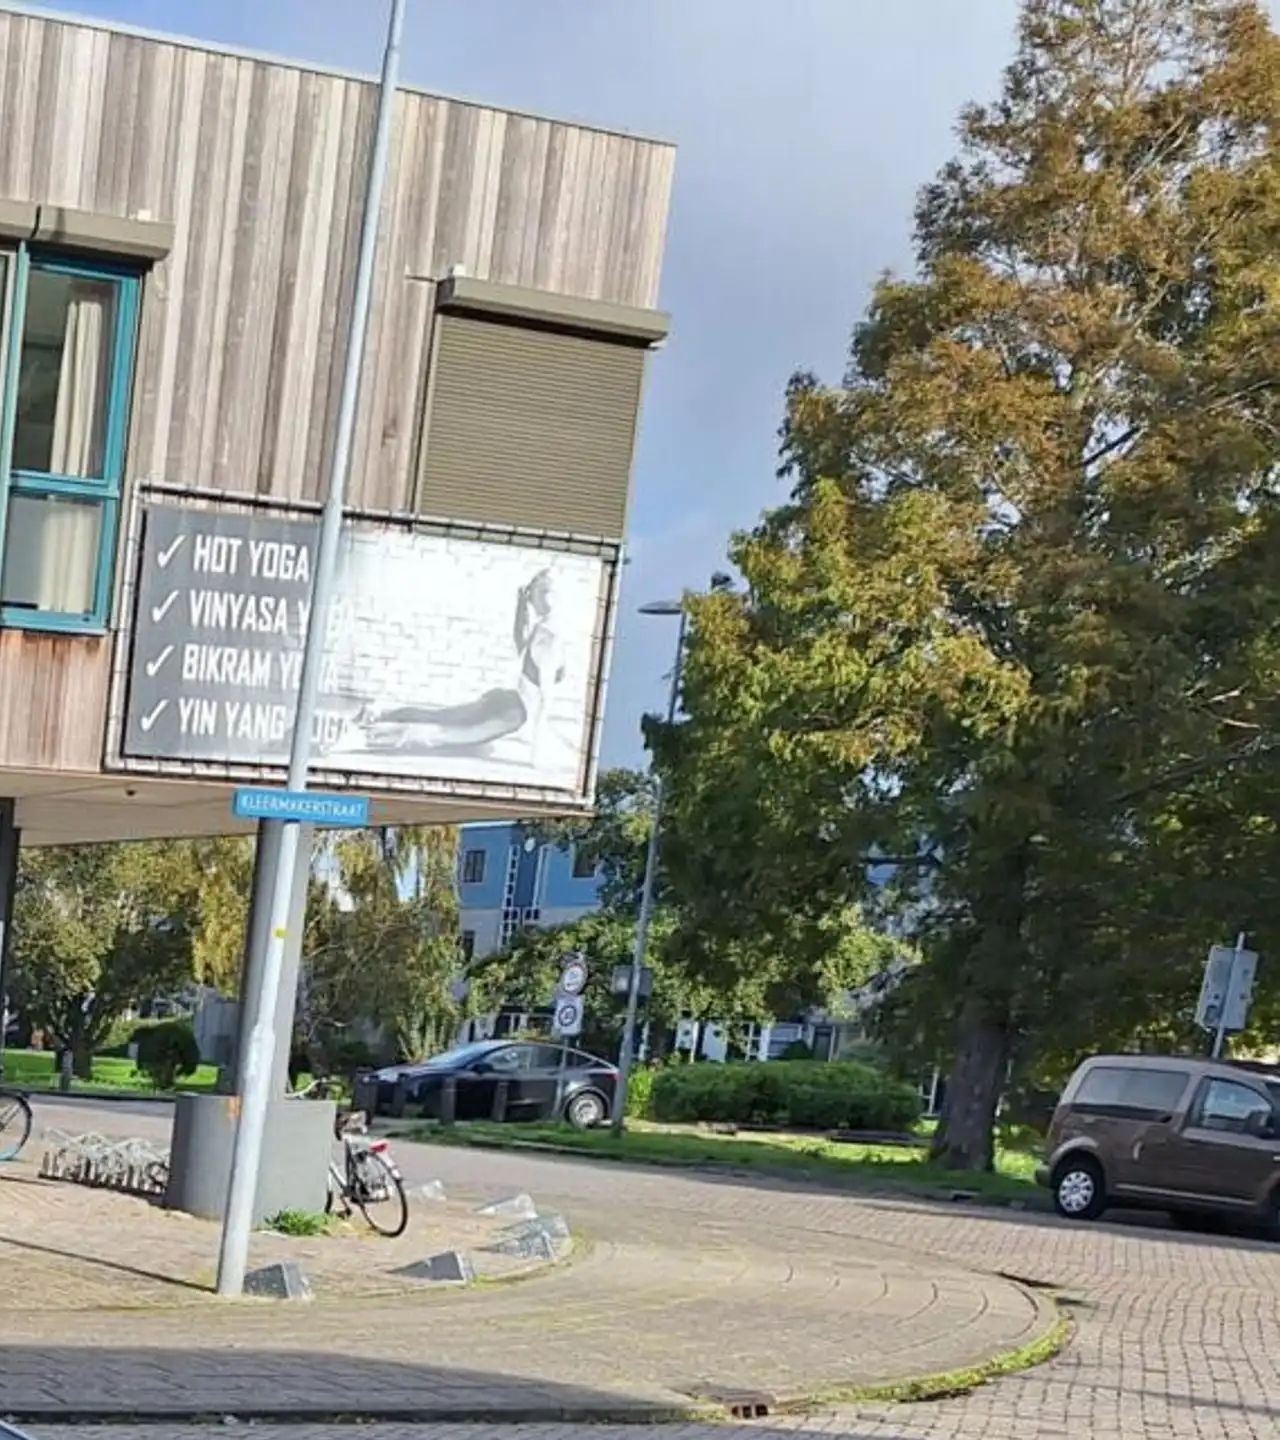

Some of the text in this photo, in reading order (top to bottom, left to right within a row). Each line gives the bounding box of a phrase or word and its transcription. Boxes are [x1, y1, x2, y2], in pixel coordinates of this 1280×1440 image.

[193, 533, 310, 583] HOT YOGA
[190, 588, 288, 635] VINYASA
[182, 643, 271, 689] BIKRAM
[178, 696, 218, 736] YIN
[224, 700, 288, 744] YANG
